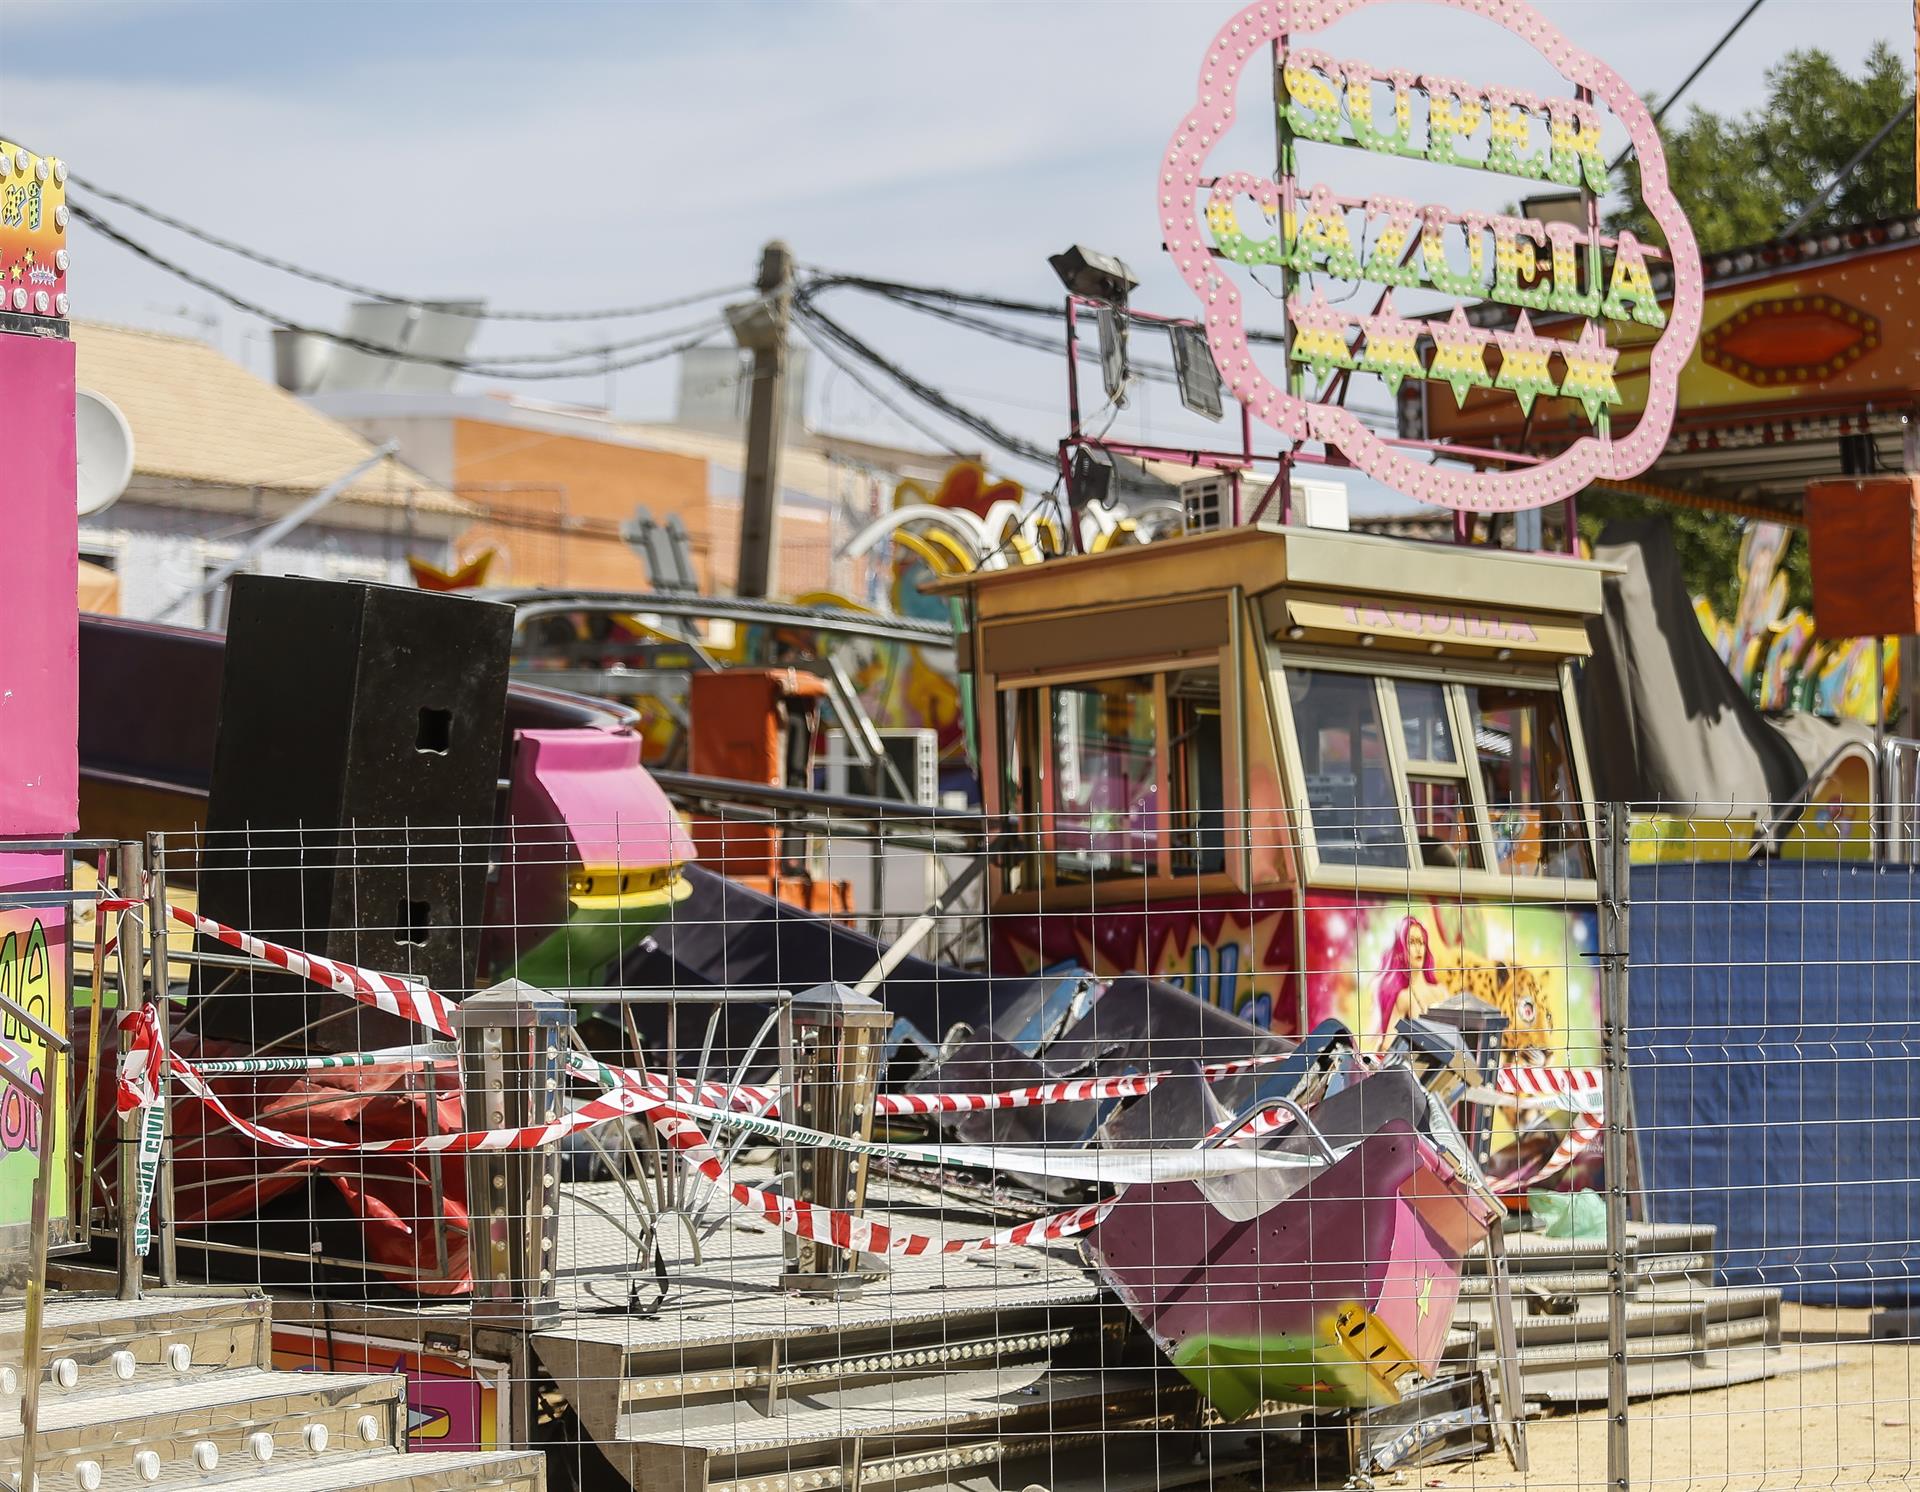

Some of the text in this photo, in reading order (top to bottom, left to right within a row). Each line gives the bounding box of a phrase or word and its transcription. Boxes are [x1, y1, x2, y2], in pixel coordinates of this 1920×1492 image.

[1283, 49, 1611, 195] SUPER
[1206, 171, 1667, 328] CAZUELA
[1340, 601, 1538, 643] TAQUILLA
